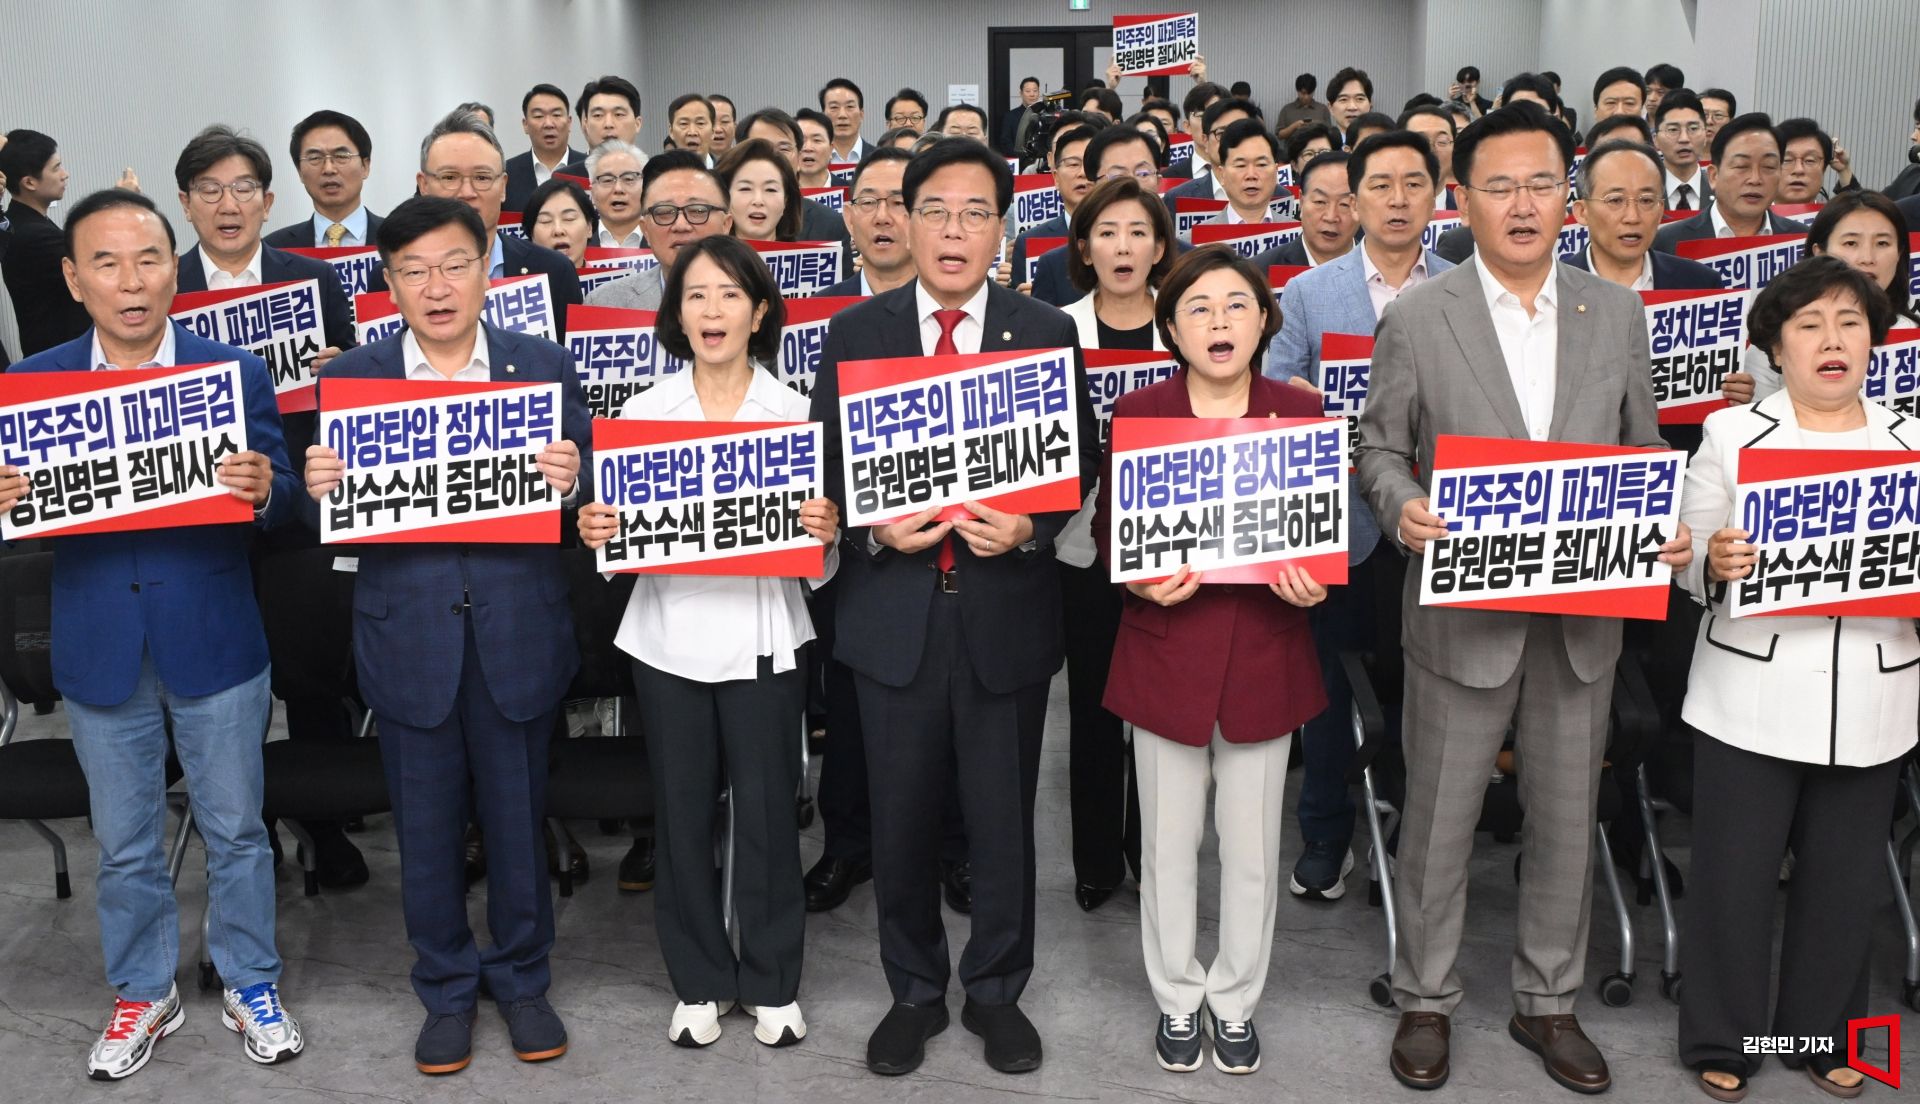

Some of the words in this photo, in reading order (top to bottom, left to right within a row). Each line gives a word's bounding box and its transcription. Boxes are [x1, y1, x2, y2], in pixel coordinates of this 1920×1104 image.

[1116, 25, 1154, 50] 민주주의
[1158, 17, 1196, 43] 파괴특검
[1116, 47, 1155, 71] 당원명부
[1158, 40, 1196, 66] 절대사수
[1018, 190, 1065, 223] 야당탄
[335, 256, 378, 299] 정치
[1757, 244, 1805, 288] 파괴
[224, 286, 317, 346] 파괴특검
[483, 281, 549, 333] 치보복
[1651, 297, 1743, 354] 정치보복
[571, 333, 658, 380] 민주주의
[783, 325, 829, 375] 야당
[1651, 346, 1740, 402] 중단하라
[0, 397, 115, 467] 민주주의
[121, 371, 236, 444] 파괴특검
[847, 381, 954, 455] 민주주의
[960, 357, 1068, 431] 파괴특검
[1324, 365, 1370, 411] 민주
[328, 405, 439, 469] 야당탄압
[446, 391, 553, 457] 정치보복
[328, 464, 438, 531] 압수수색
[601, 446, 705, 506] 야당탄압
[712, 430, 816, 494] 정치보복
[851, 442, 958, 514] 당원명부
[964, 419, 1071, 492] 절대사수
[1119, 444, 1226, 511] 야당탄압
[1233, 428, 1340, 497] 정치보복
[1437, 468, 1553, 532] 민주주의
[1558, 459, 1677, 521] 파괴특검
[1119, 504, 1224, 572] 압수수색
[1233, 489, 1342, 557] 중단하라
[1743, 478, 1861, 544] 야당탄압
[1431, 531, 1546, 594] 당원명부
[1552, 522, 1667, 584] 절대사수
[1739, 538, 1855, 606] 압수수색
[1859, 530, 1920, 590] 중단
